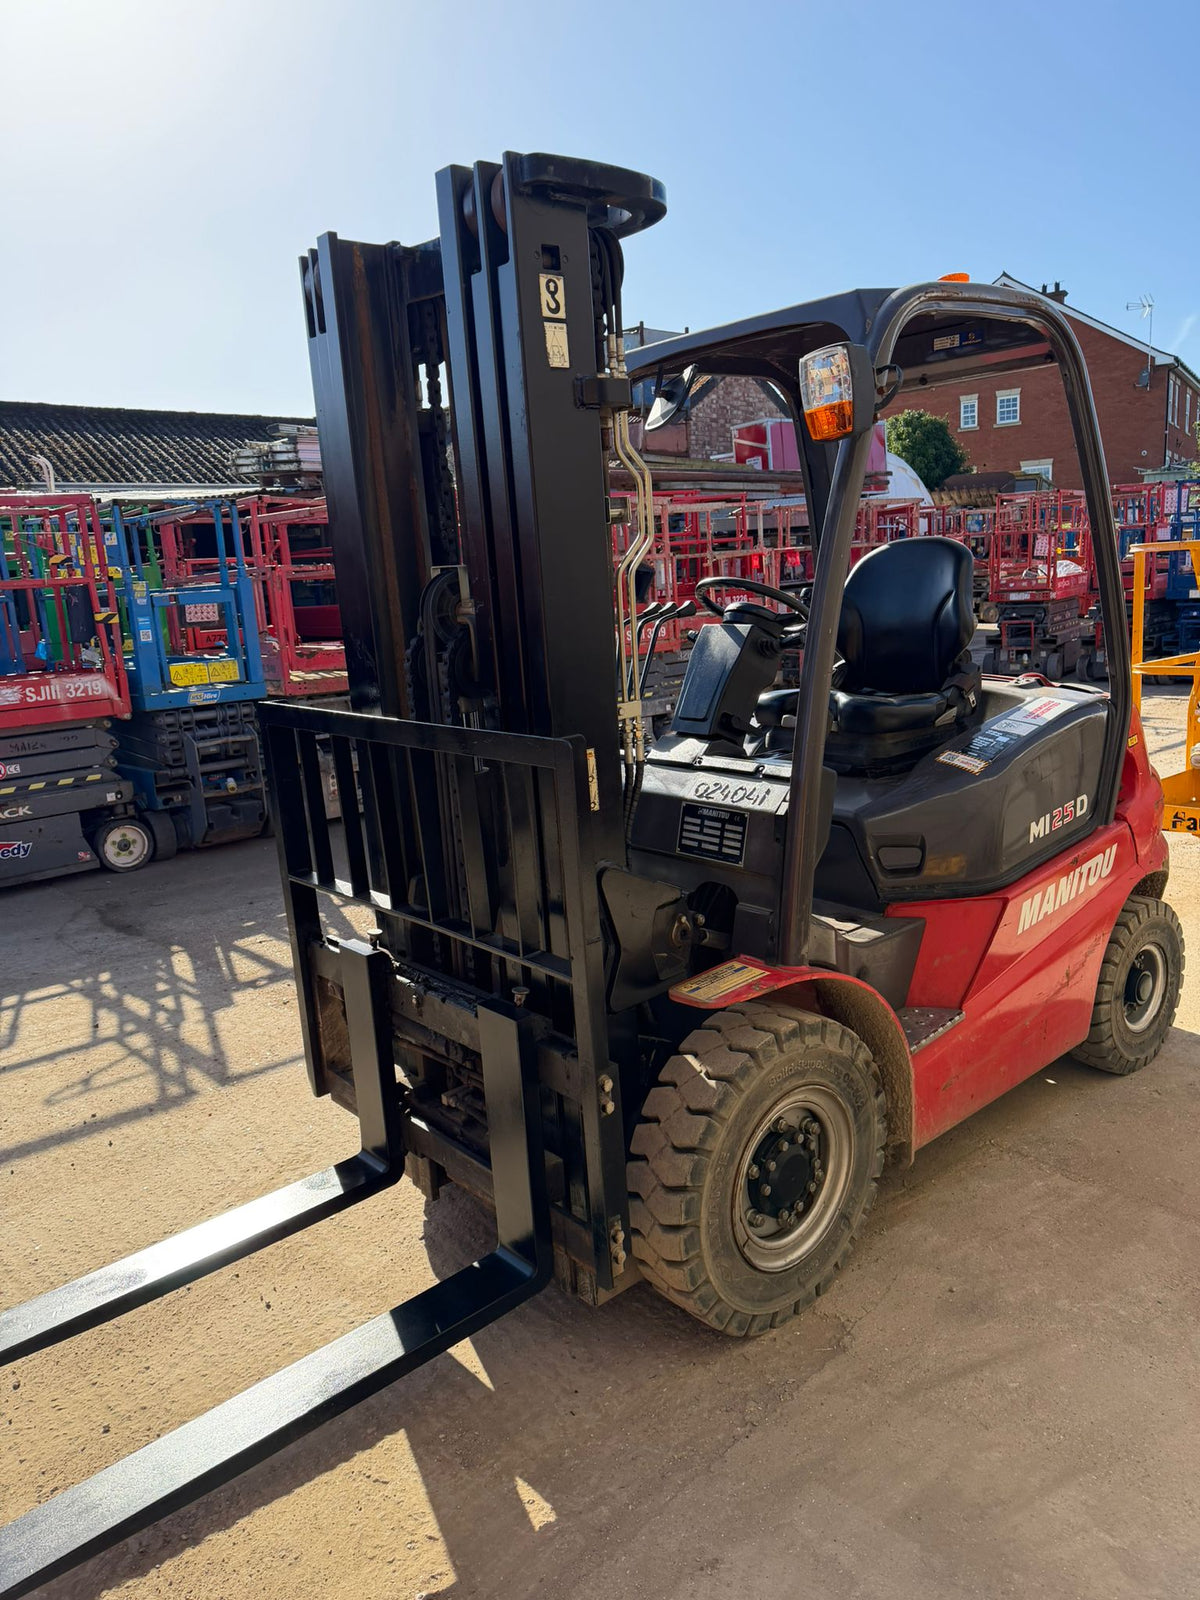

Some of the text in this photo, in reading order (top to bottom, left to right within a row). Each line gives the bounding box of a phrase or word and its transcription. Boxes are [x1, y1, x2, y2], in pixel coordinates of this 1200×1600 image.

[25, 686, 61, 703] SJIII
[66, 681, 102, 698] 3219
[695, 783, 771, 805] 024041
[1016, 842, 1118, 936] MANITOU
